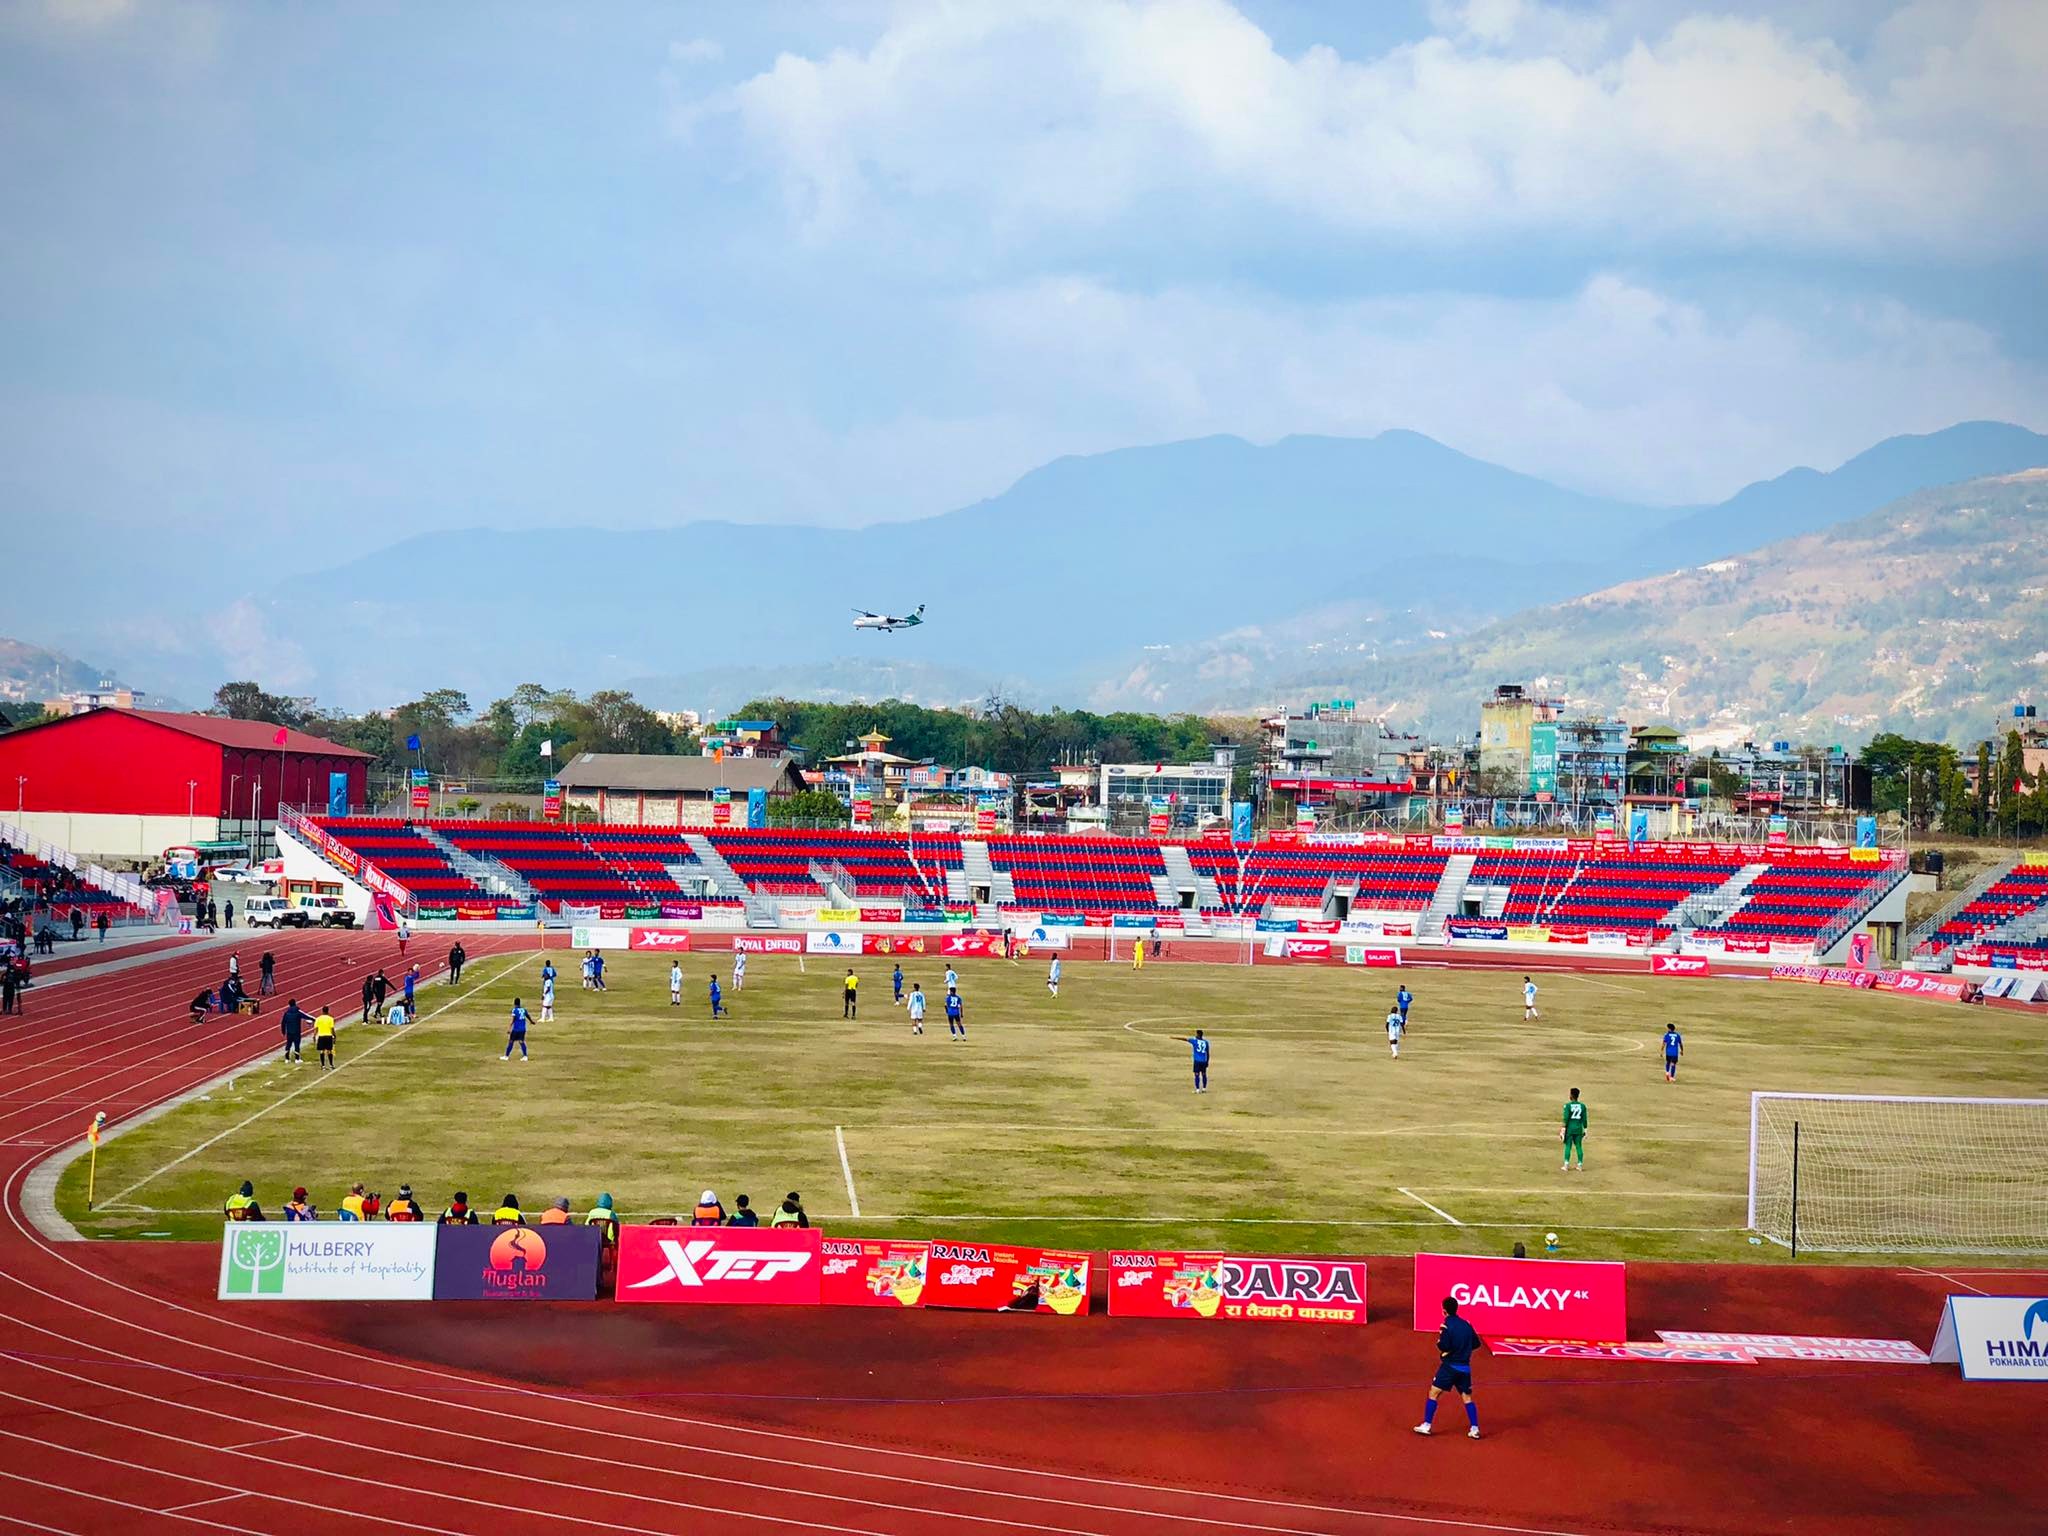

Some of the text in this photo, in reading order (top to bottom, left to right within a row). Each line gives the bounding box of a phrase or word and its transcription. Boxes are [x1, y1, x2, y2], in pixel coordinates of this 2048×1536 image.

[328, 838, 358, 867] RARA
[635, 931, 687, 946] XTEP
[734, 938, 801, 952] ROYAL ENFIELD
[1660, 956, 1706, 971] XTEP
[289, 1242, 375, 1257] MULBERRY
[821, 1243, 862, 1256] RARA
[932, 1245, 990, 1263] RARA
[626, 1240, 812, 1288] XTEP
[1112, 1255, 1157, 1267] RARA
[287, 1259, 427, 1282] Institute of Hospitality
[1223, 1263, 1363, 1303] RARA
[1450, 1283, 1589, 1311] GALAXY 4K
[1989, 1358, 2031, 1367] POKHARA
